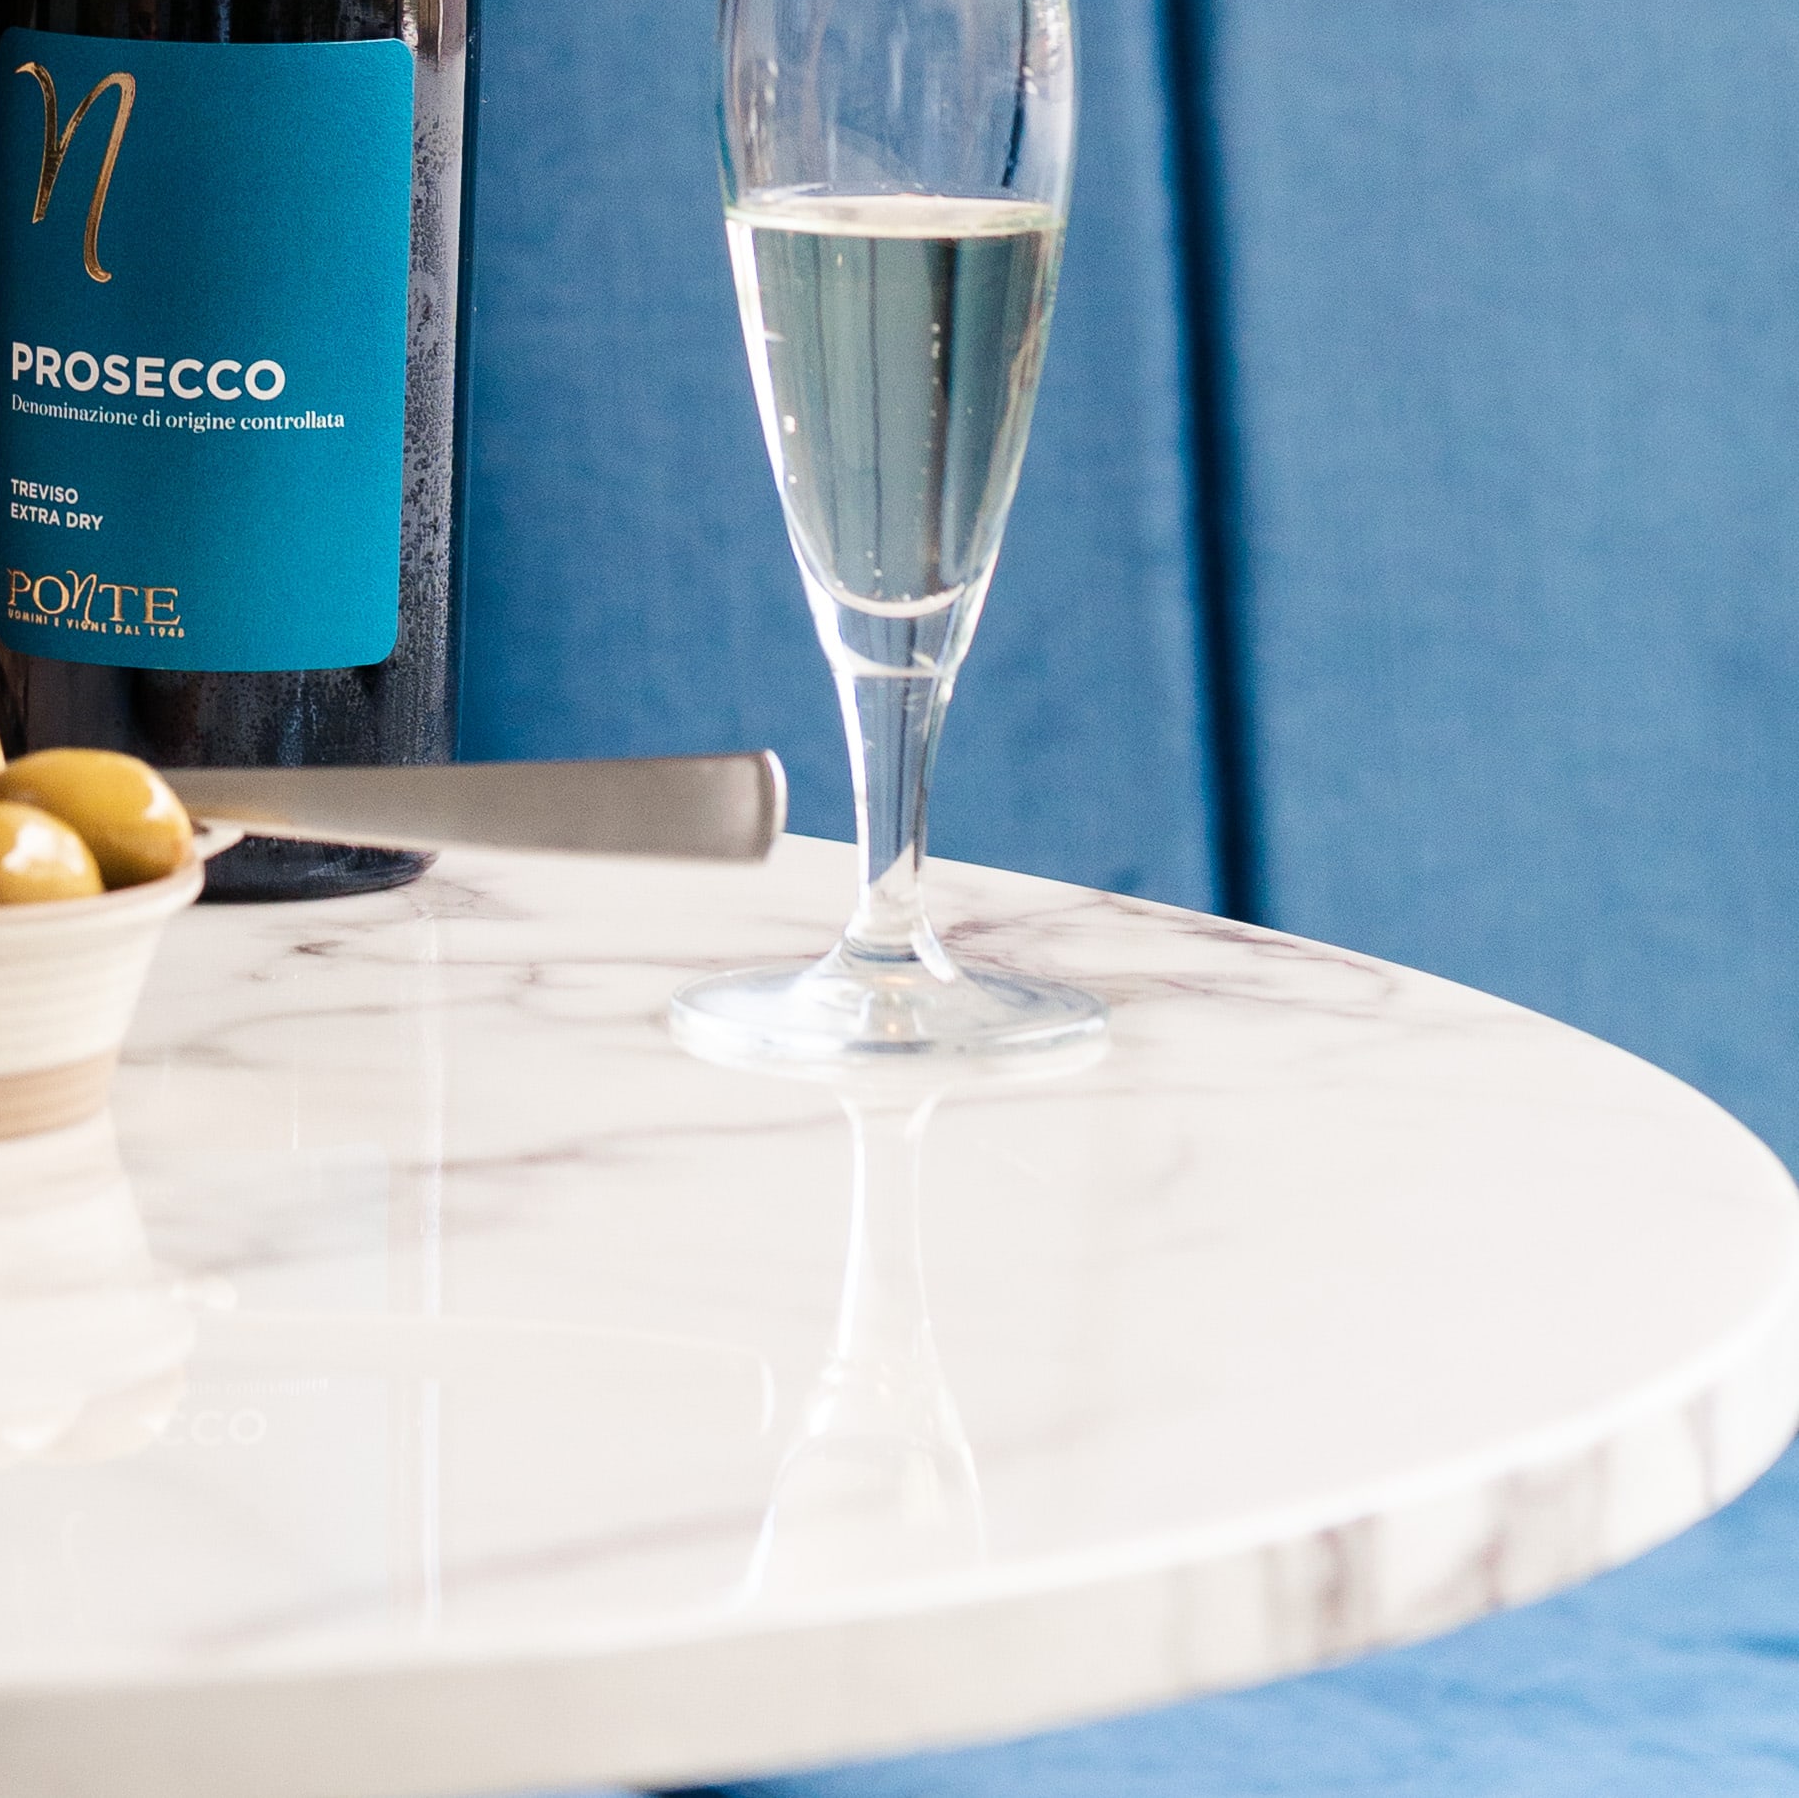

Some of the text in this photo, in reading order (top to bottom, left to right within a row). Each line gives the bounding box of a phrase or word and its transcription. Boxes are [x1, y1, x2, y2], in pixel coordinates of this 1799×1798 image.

[11, 341, 286, 401] PROSECCO
[11, 393, 345, 434] Denominazione di origine controllata
[10, 478, 79, 504] TREVISO
[10, 502, 103, 531] EXTRA DRY
[7, 608, 49, 625] UOMINI
[66, 619, 107, 633] VIGNE
[115, 624, 141, 635] DAL
[150, 626, 185, 638] 1948
